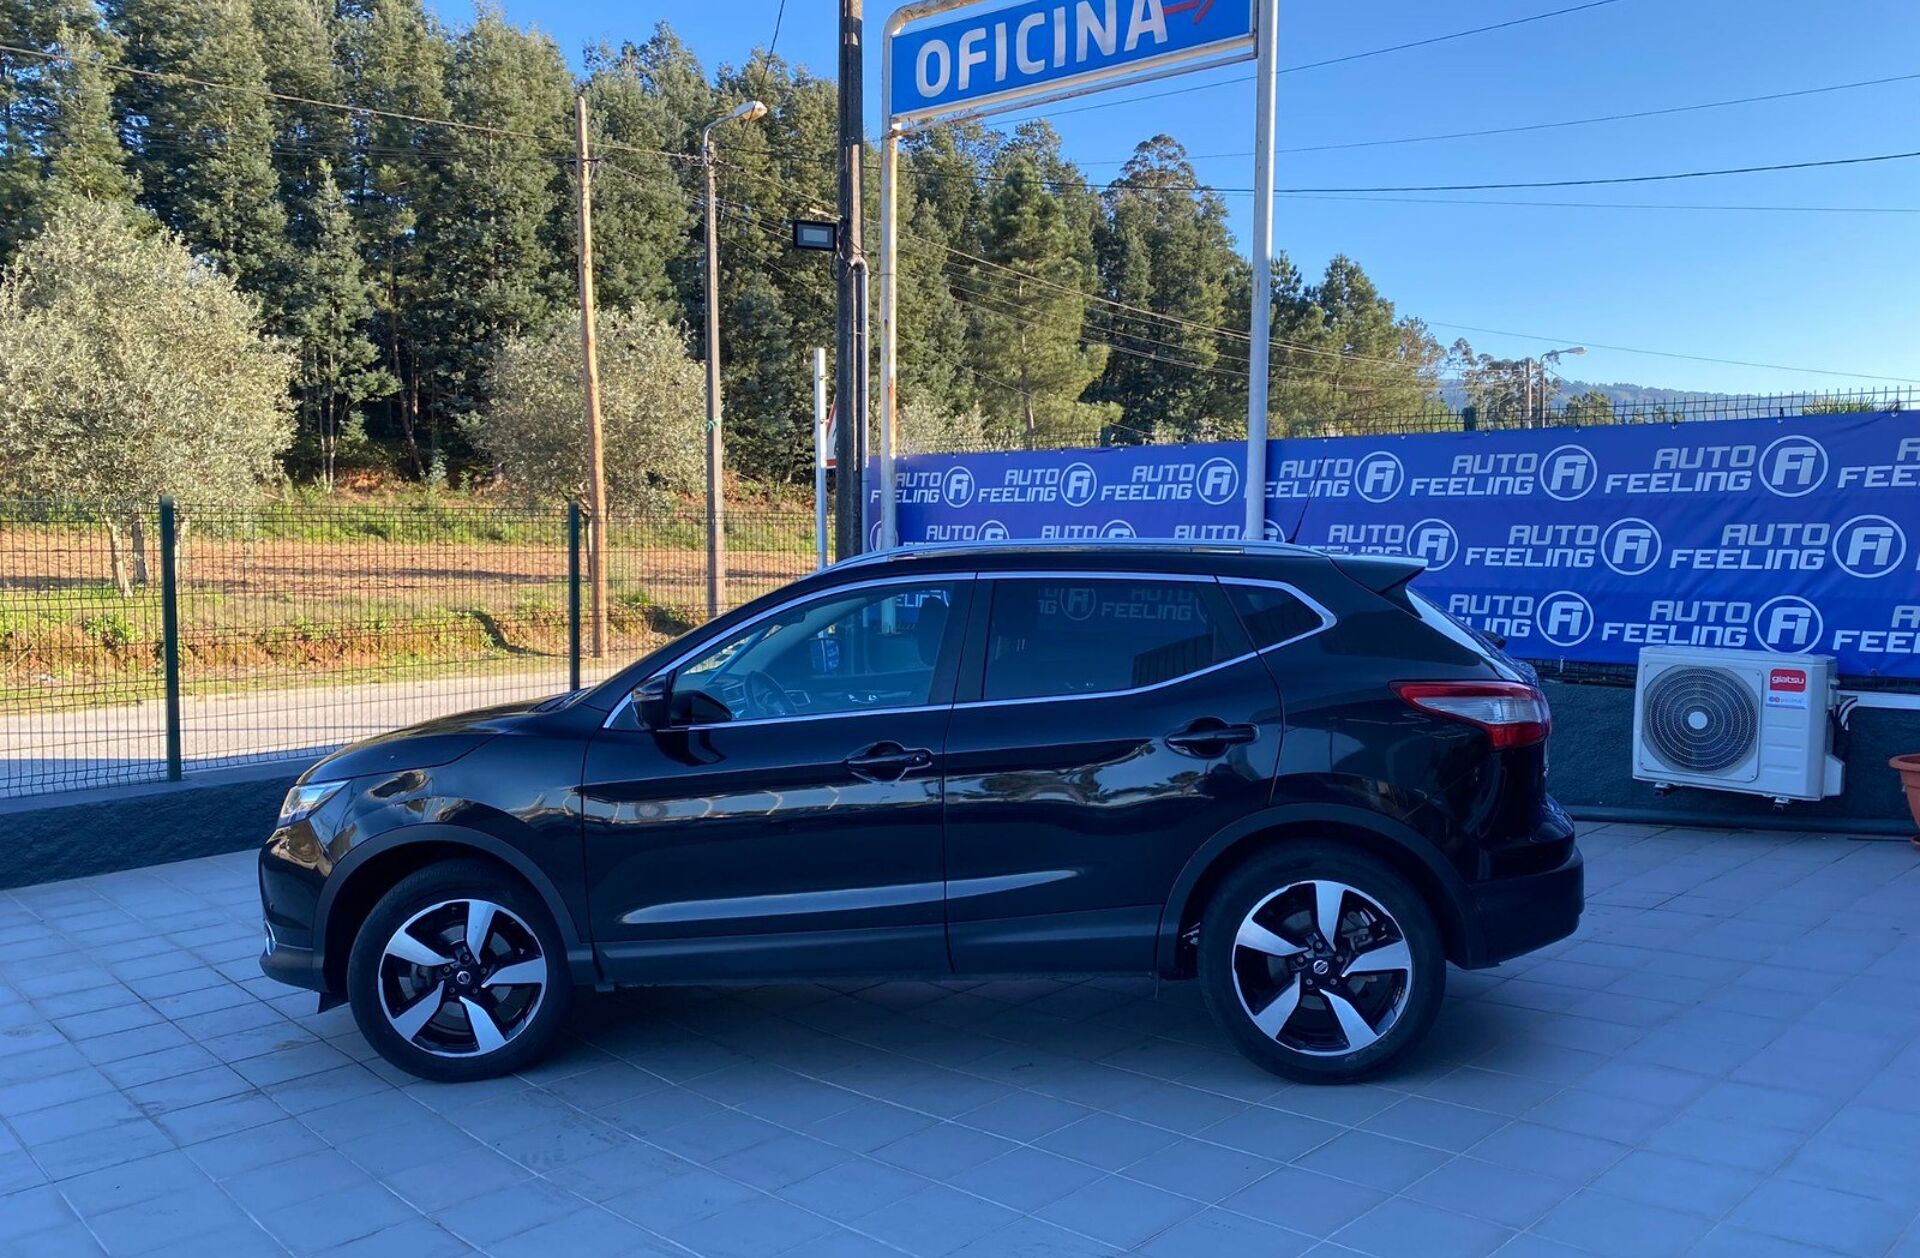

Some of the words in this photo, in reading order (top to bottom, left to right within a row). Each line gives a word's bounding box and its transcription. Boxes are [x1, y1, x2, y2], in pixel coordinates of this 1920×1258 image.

[915, 0, 1167, 98] OFICINA
[1452, 453, 1538, 475] AUTO
[1653, 444, 1756, 470] AUTO
[1004, 468, 1059, 486] AUTO
[1131, 464, 1196, 482] AUTO
[1280, 458, 1354, 478] AUTO
[1101, 484, 1193, 501] FEELING
[1244, 480, 1350, 498] EELING
[1410, 476, 1534, 496] FEELING
[1605, 471, 1752, 494] FEELING
[870, 489, 940, 504] FELING
[926, 525, 976, 541] AUTO
[1041, 525, 1098, 540] AUTO
[1327, 524, 1405, 544] AUTO
[1508, 525, 1598, 545] AUTO
[1721, 523, 1830, 546] AUTO
[1465, 547, 1596, 568] FEELING
[1669, 549, 1825, 570] FEELING
[1449, 593, 1534, 616] AUTO
[1650, 600, 1751, 624] AUTO
[1602, 622, 1748, 647] FEELING
